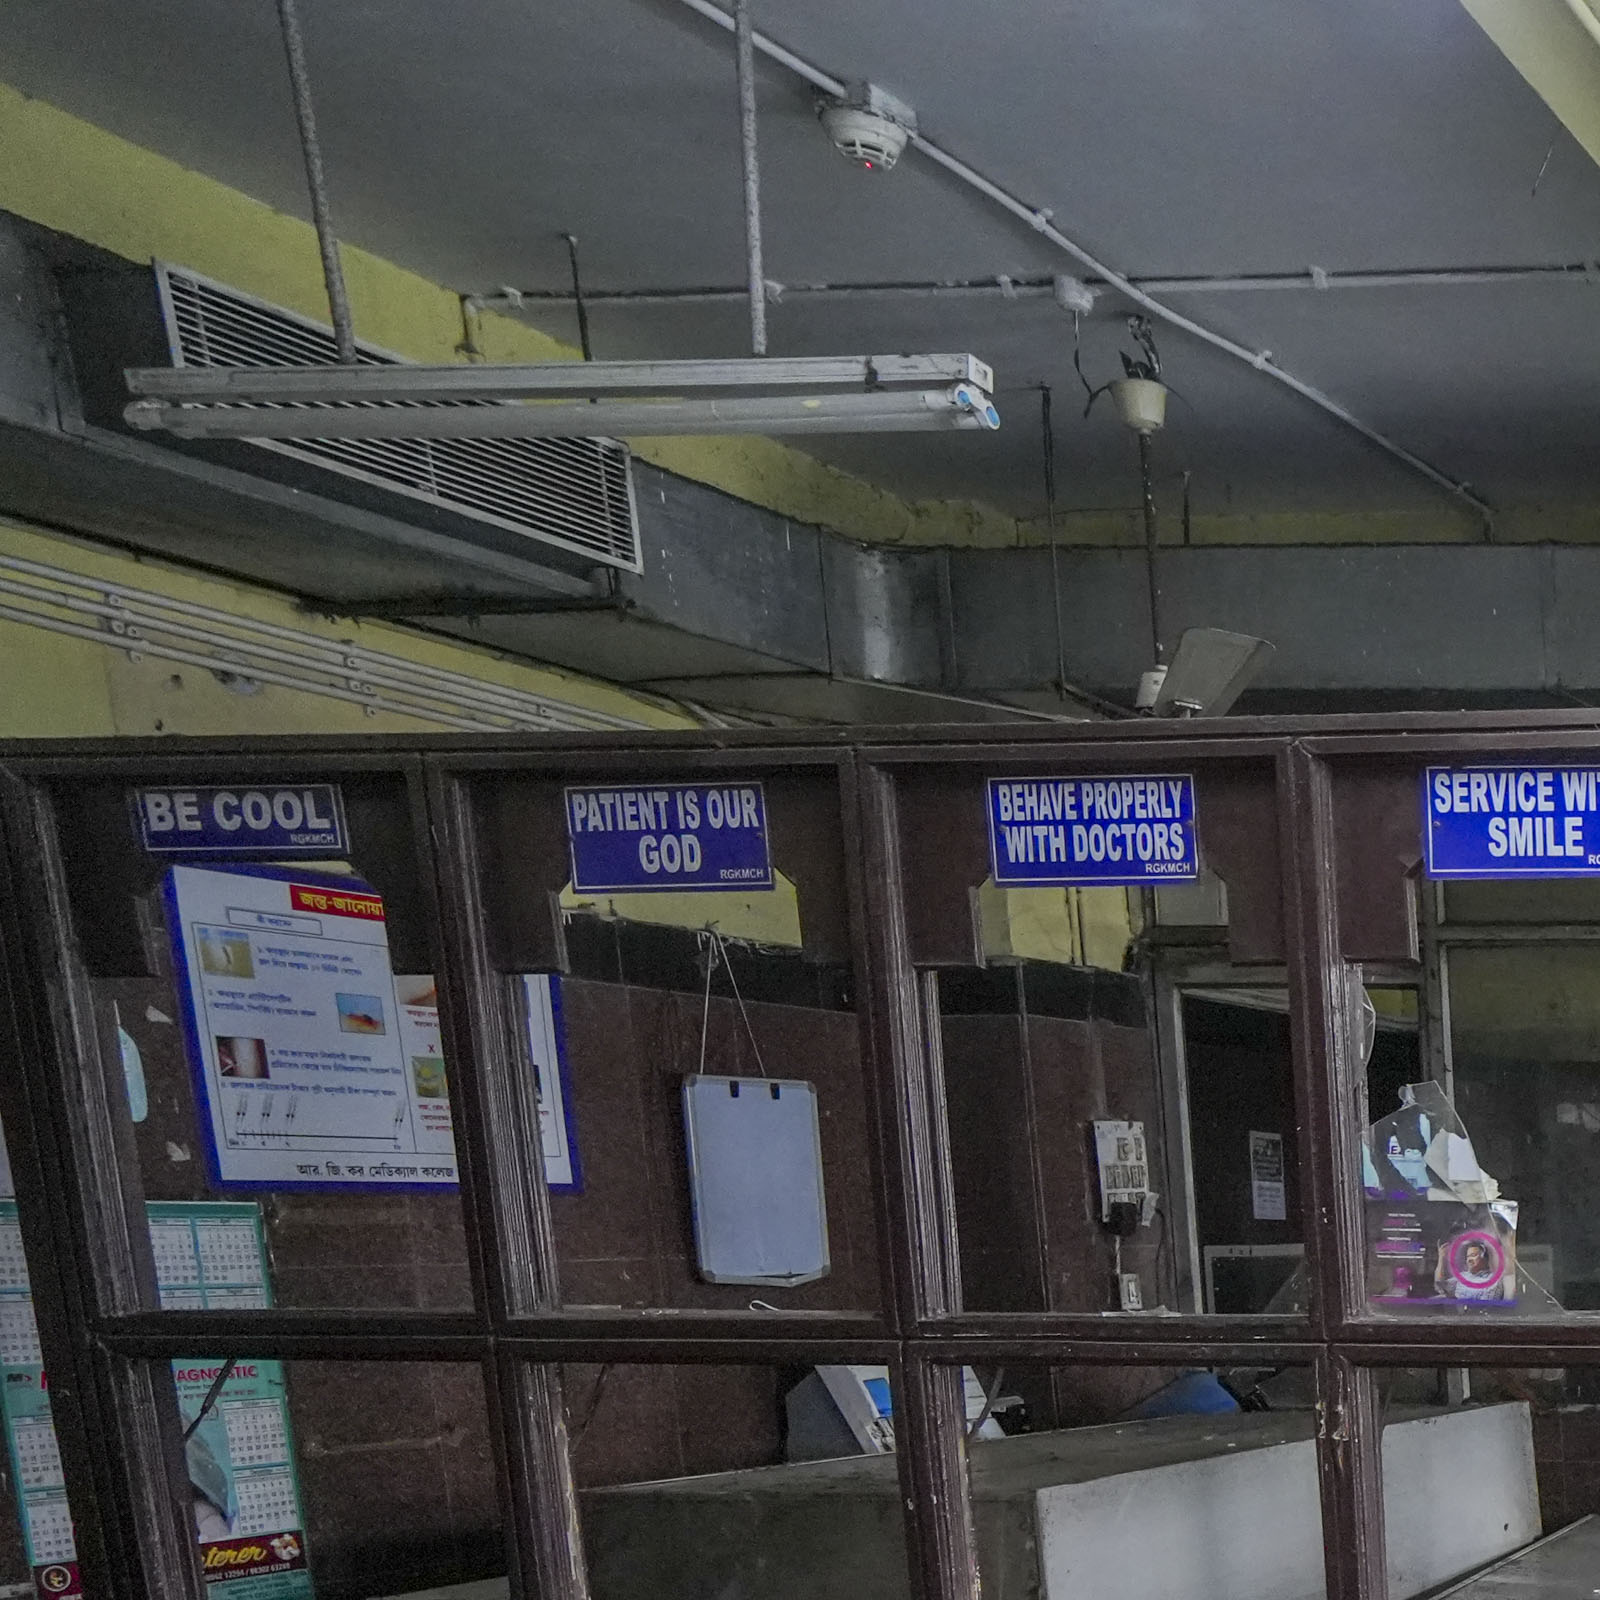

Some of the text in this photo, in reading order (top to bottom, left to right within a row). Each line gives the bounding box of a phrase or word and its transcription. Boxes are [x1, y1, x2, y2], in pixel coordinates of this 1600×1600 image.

[145, 791, 331, 832] BE COOL
[571, 789, 760, 832] PATIENT IS OUR
[998, 781, 1183, 821] BEHAVE PROPERLY
[1434, 772, 1555, 814] SERVICE
[291, 833, 335, 844] RGKMCH
[639, 834, 702, 874] GOD
[1005, 823, 1185, 863] WITH DOCTORS
[1488, 816, 1584, 857] SMILE
[720, 869, 764, 879] RGKMCH
[1145, 863, 1191, 873] RGKMCH
